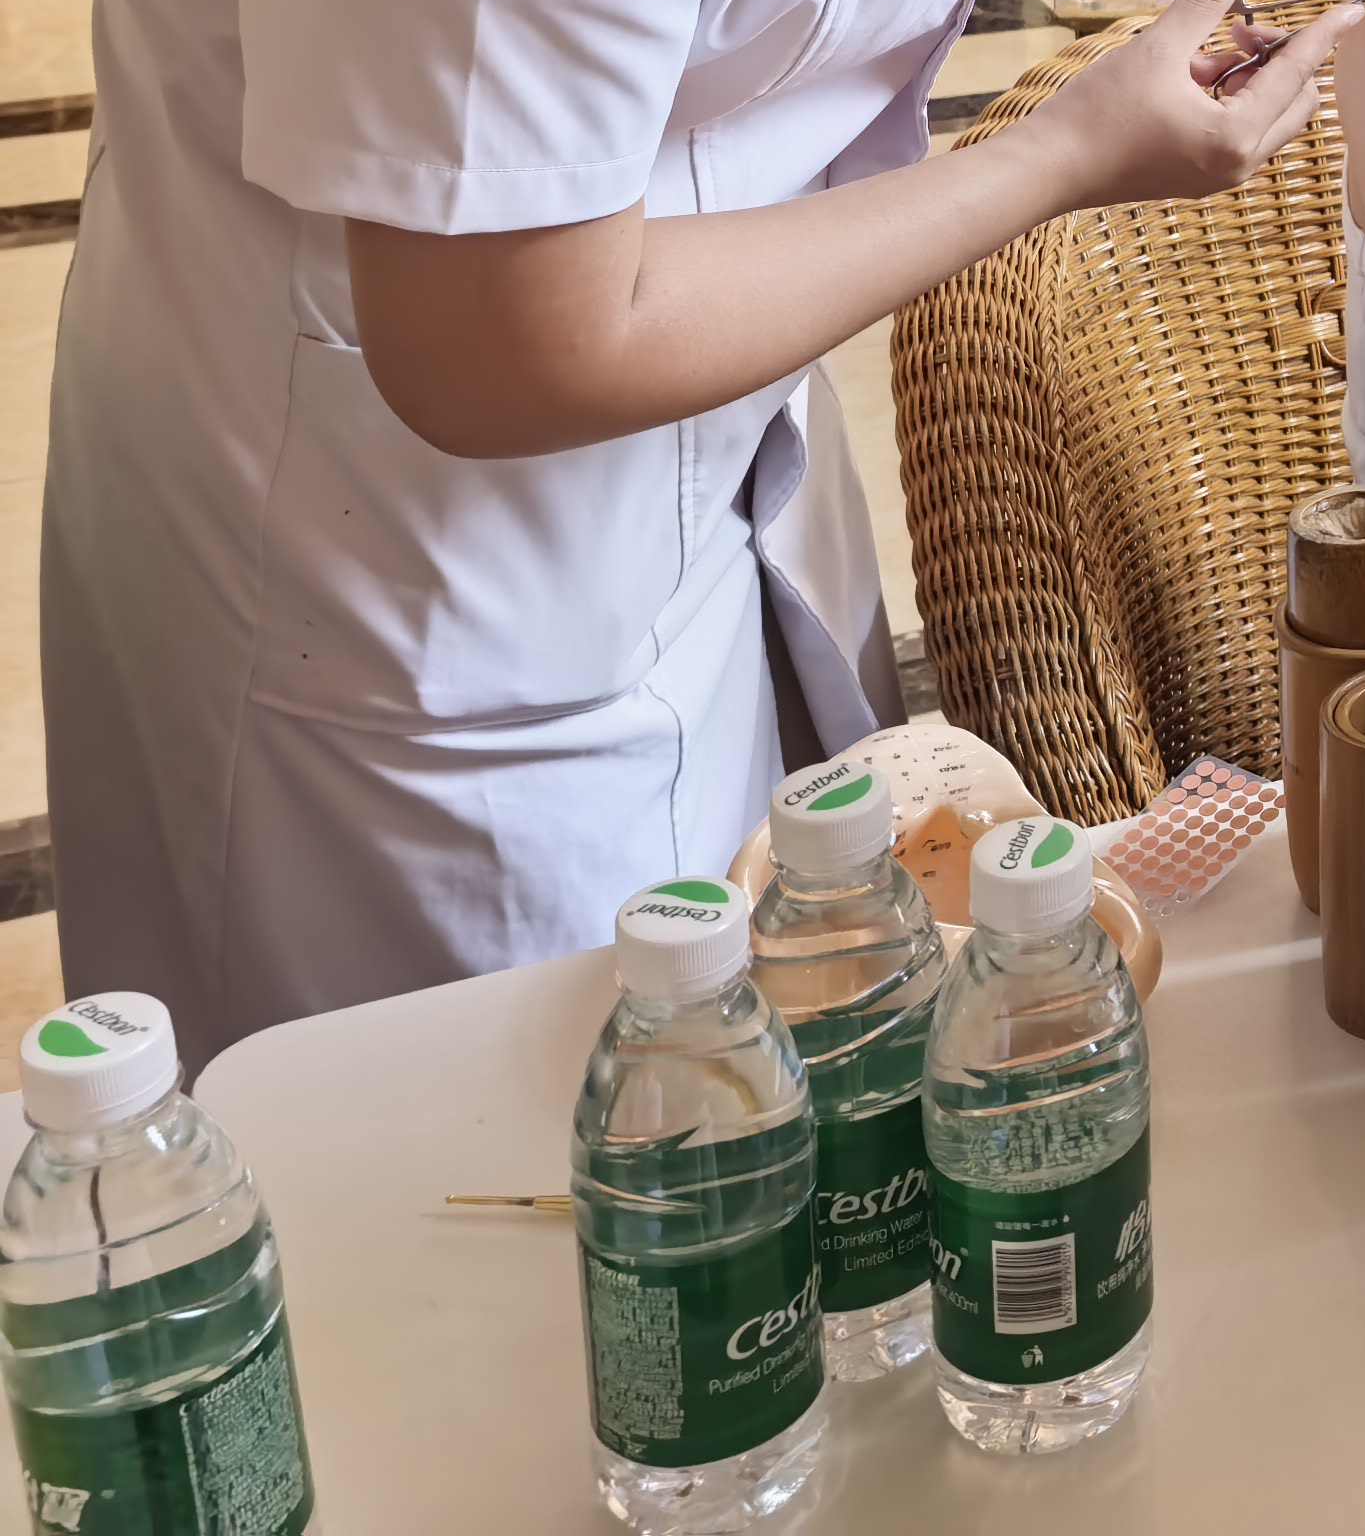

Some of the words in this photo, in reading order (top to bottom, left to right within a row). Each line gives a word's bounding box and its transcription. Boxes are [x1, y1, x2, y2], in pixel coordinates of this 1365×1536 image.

[784, 765, 850, 808] C'estbon
[1000, 820, 1036, 871] C'estbon
[637, 902, 722, 923] C'estbon
[68, 1001, 138, 1036] C'estbon
[833, 1228, 888, 1252] Drinking
[844, 1247, 895, 1272] Limited
[709, 1364, 760, 1396] Purified
